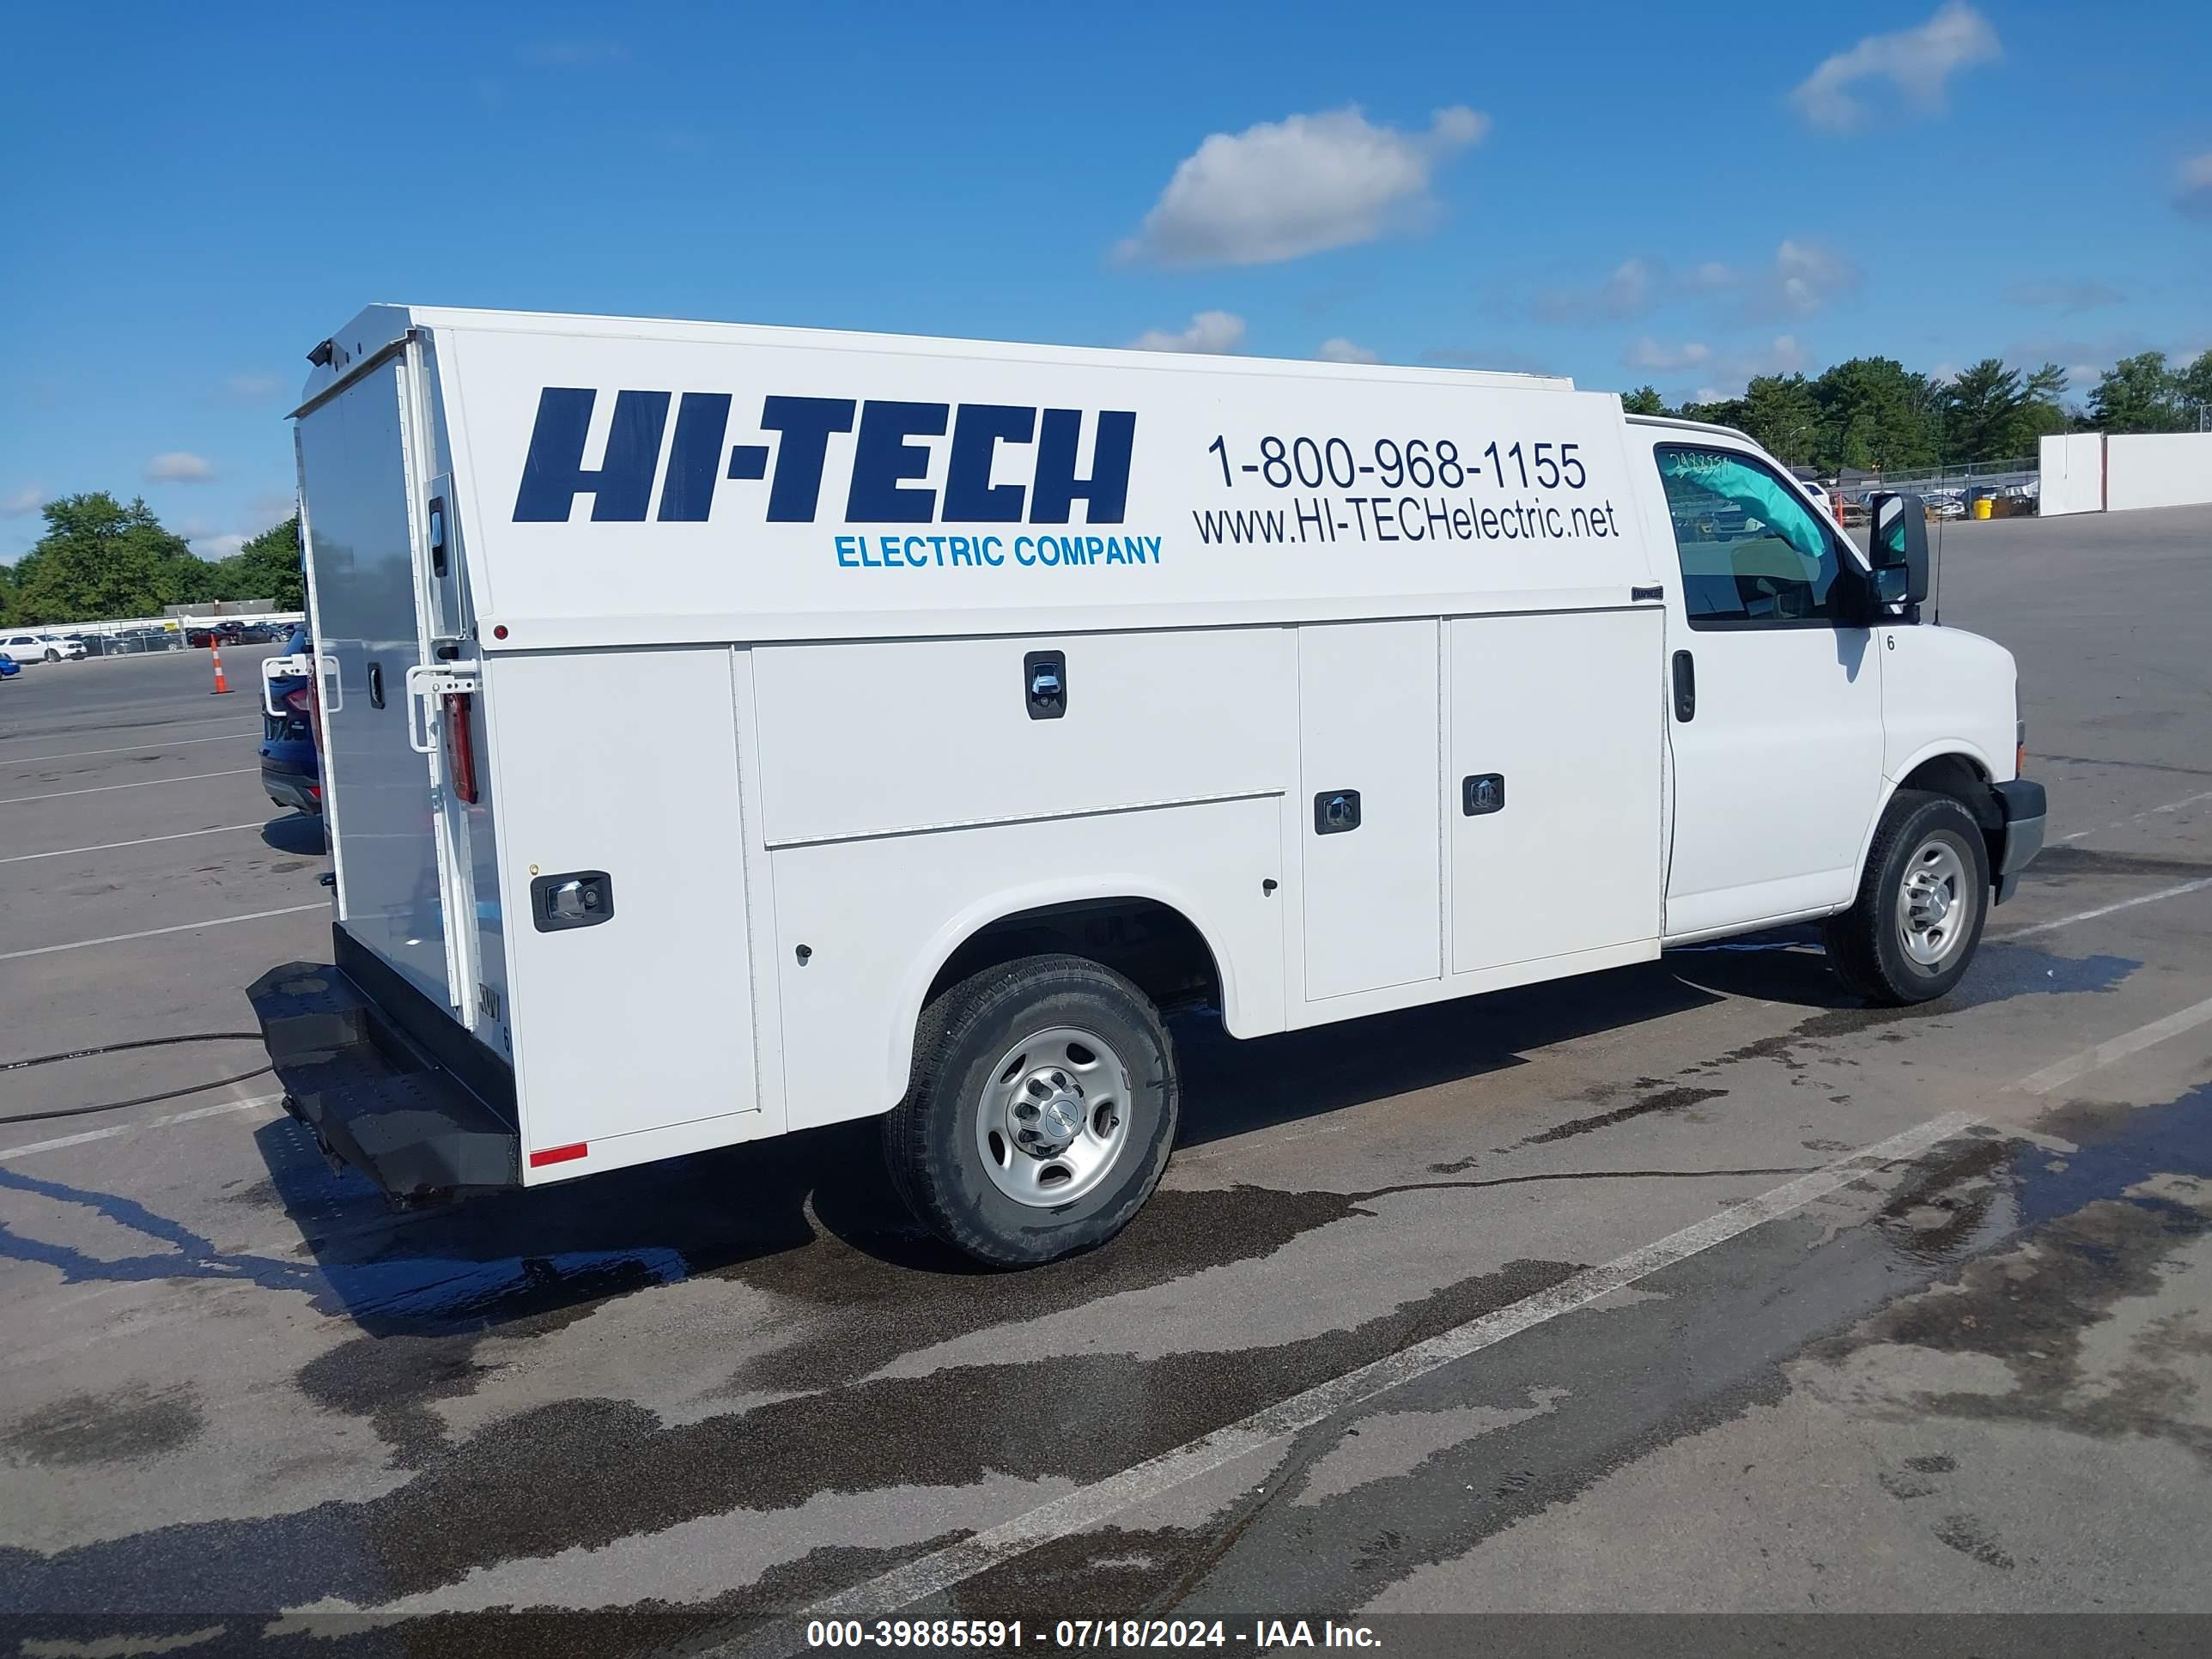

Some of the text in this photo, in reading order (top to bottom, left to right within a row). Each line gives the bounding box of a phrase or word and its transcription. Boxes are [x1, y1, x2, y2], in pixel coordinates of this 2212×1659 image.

[511, 386, 1137, 525] HI-TECH
[1208, 434, 1586, 489] 1-800-968-1155
[1192, 496, 1620, 544] www.HI-TECHelectric.net
[834, 535, 1162, 568] ELECTRIC COMPANY
[1887, 635, 1895, 651] 6
[503, 1026, 510, 1053] 6
